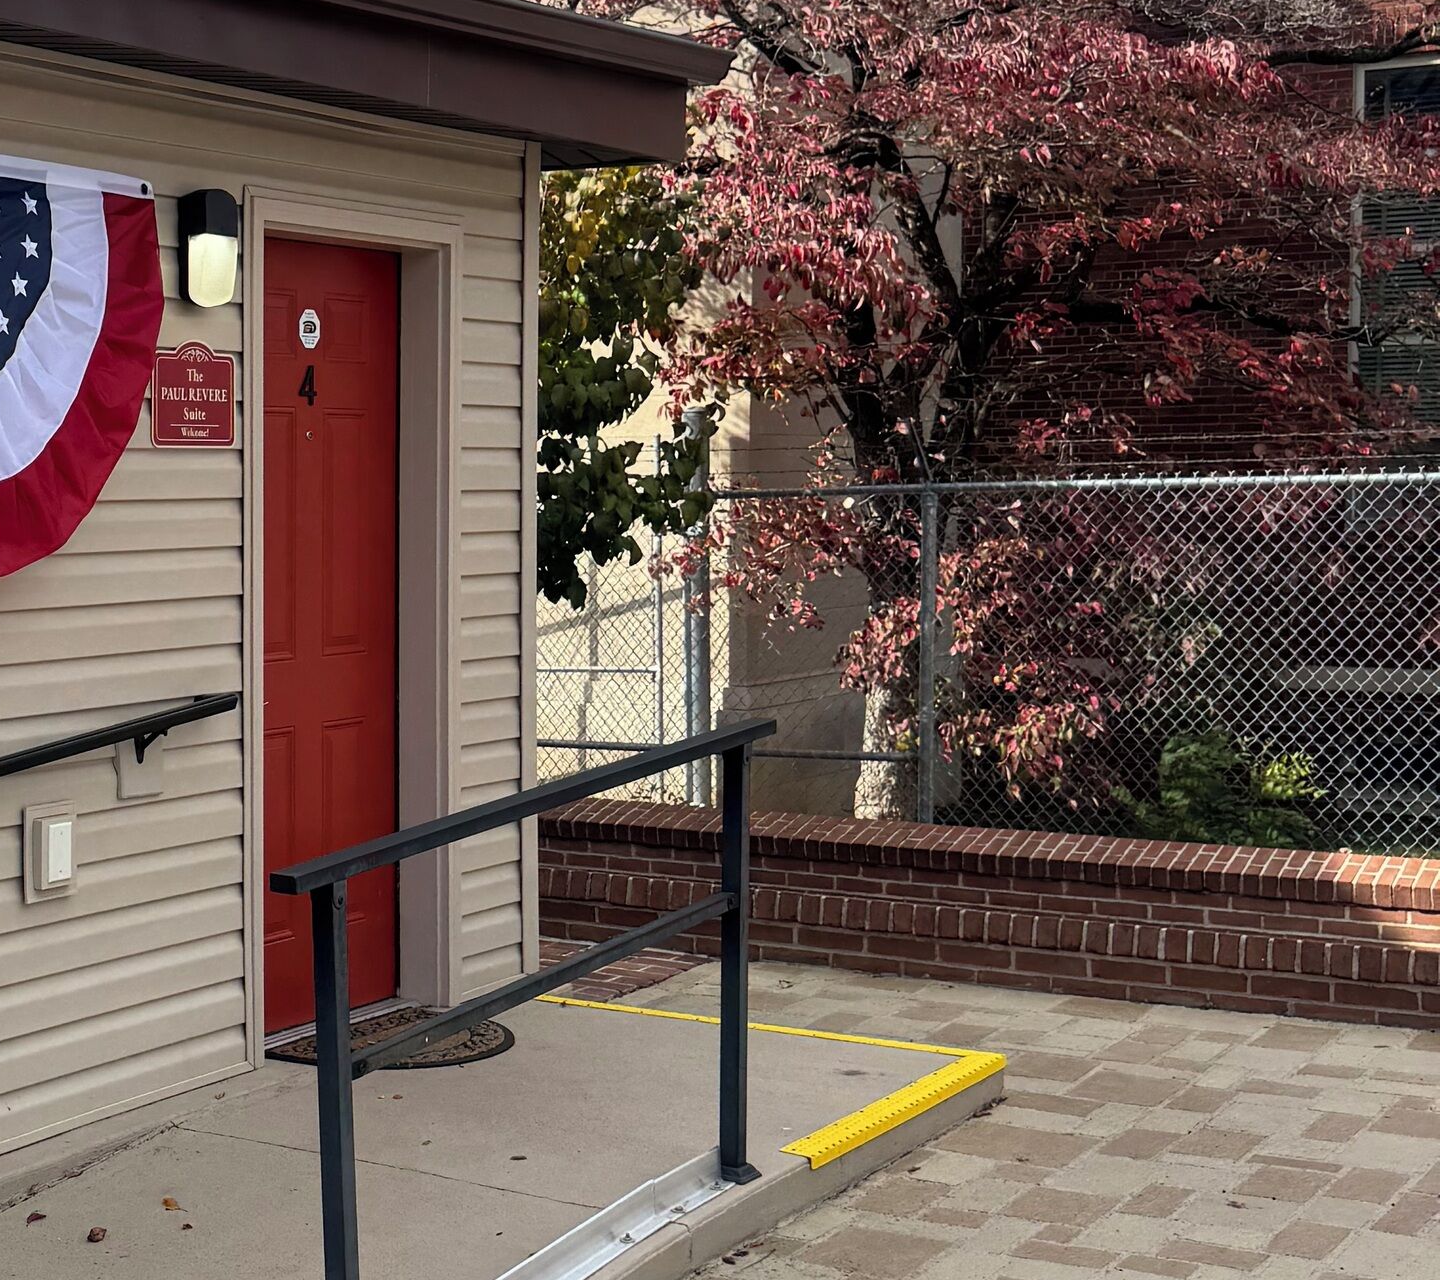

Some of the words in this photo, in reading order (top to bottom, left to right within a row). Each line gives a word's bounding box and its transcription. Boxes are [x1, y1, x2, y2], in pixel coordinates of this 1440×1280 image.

[187, 368, 204, 382] The
[298, 365, 317, 406] 4
[161, 387, 188, 401] PAUL
[188, 387, 228, 402] REVERE
[183, 407, 206, 421] Suite
